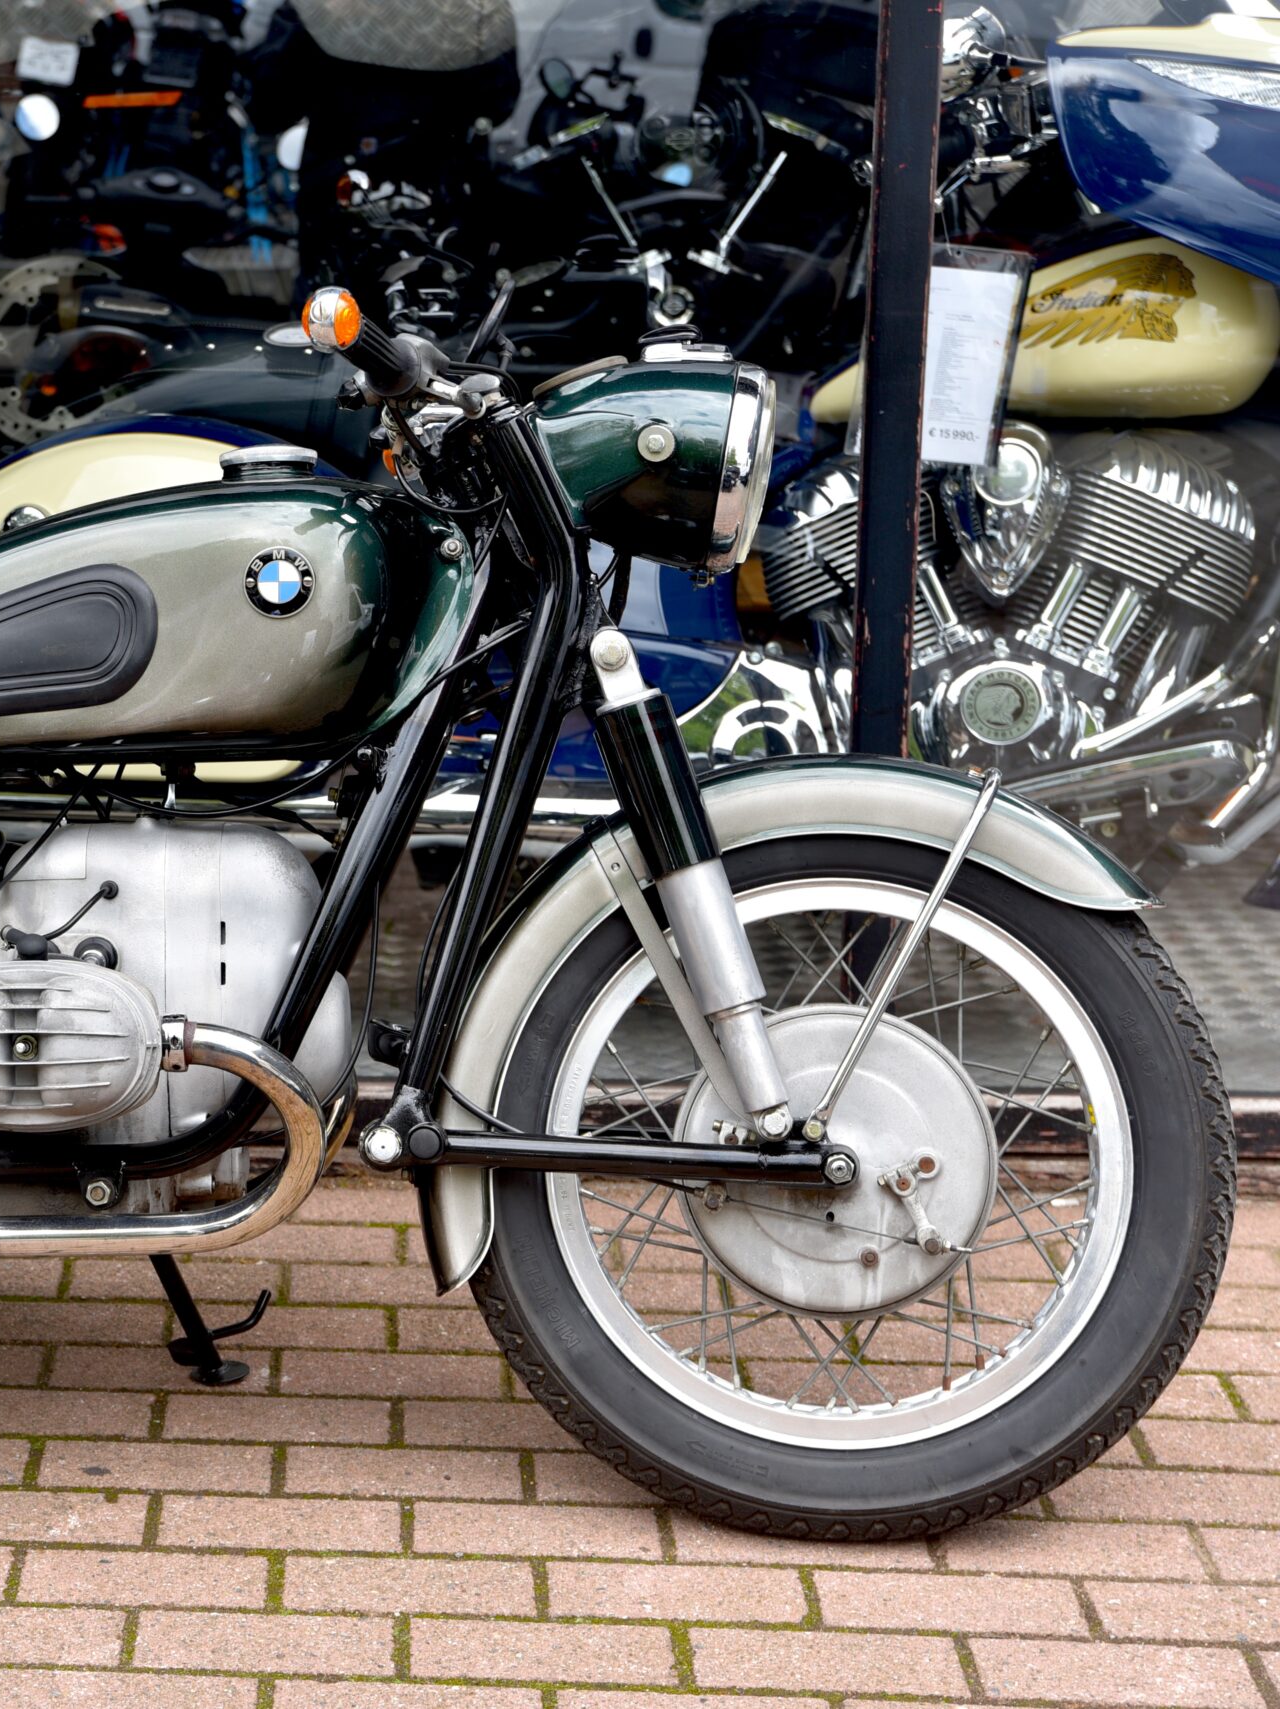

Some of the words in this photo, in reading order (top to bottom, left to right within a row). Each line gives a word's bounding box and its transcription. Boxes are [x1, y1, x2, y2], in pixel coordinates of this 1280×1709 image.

[1030, 288, 1125, 313] Indian
[251, 549, 308, 572] BMW
[515, 1233, 582, 1350] MICHELIN
